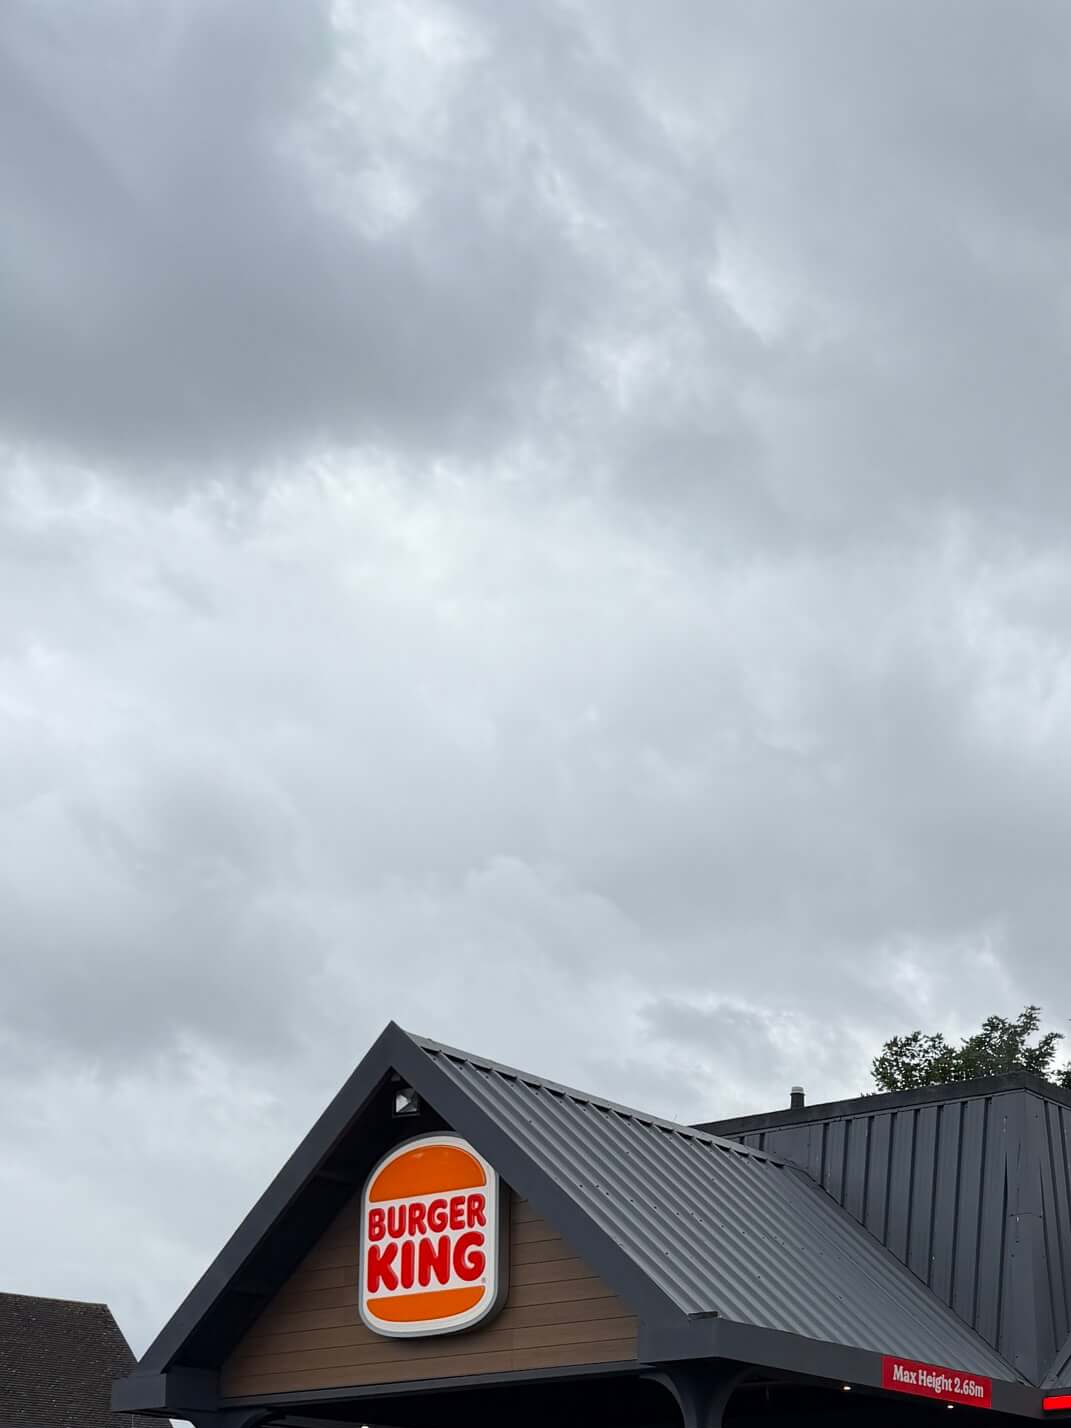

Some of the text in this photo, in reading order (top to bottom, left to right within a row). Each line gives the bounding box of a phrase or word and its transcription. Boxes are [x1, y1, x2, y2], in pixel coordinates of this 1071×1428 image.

[368, 1193, 487, 1242] BURGER
[367, 1231, 486, 1293] KING
[892, 1364, 984, 1398] Max Height 2.65m
